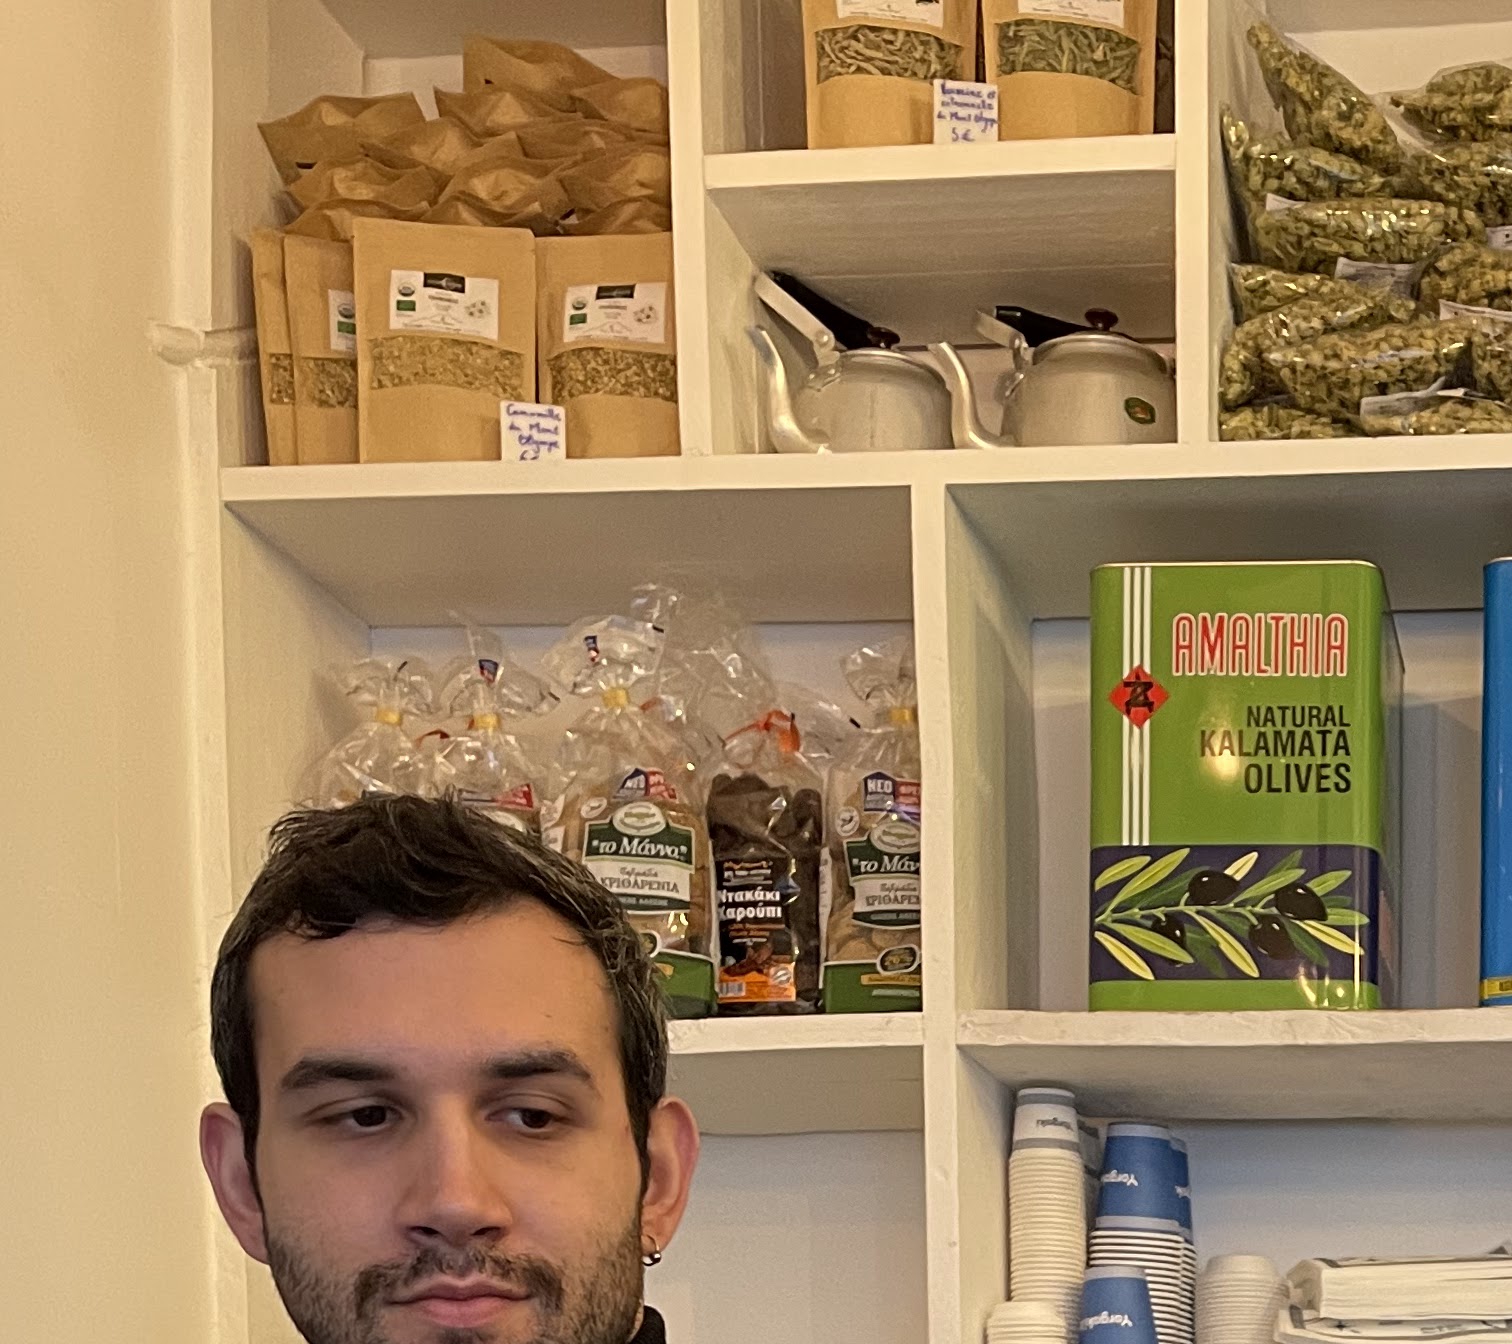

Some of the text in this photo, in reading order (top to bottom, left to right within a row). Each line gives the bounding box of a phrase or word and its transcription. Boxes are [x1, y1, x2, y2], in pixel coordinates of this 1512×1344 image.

[1172, 612, 1349, 678] AMALTHIA
[1246, 704, 1352, 728] NATURAL
[1200, 728, 1351, 757] KALAMATA
[1244, 763, 1352, 794] OLIVES
